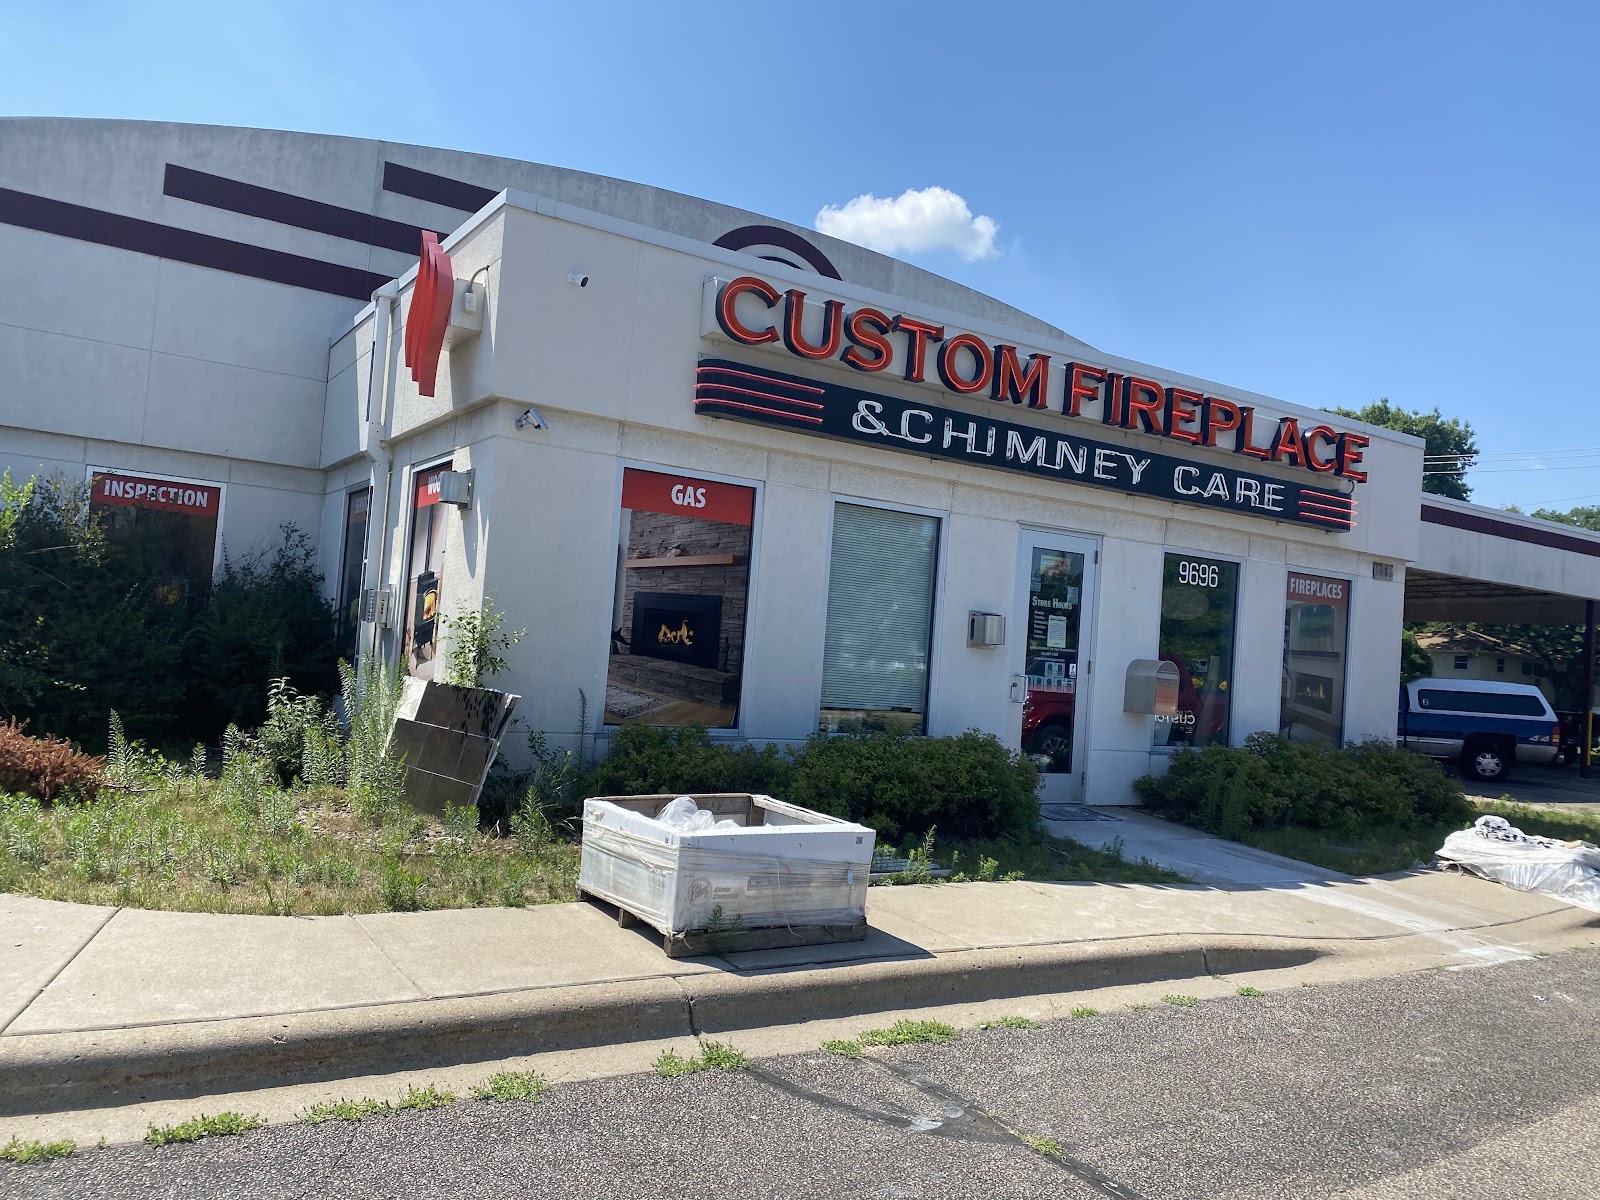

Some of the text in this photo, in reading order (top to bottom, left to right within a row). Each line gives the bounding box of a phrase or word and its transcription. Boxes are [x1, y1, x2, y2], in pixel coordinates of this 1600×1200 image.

[716, 276, 1370, 484] CUSTOM FIREPLACE
[104, 479, 208, 508] INSPECTION
[671, 484, 706, 508] GAS
[1173, 465, 1286, 511] CARE
[1178, 561, 1219, 588] 9696
[1290, 577, 1343, 600] FIREPLACES
